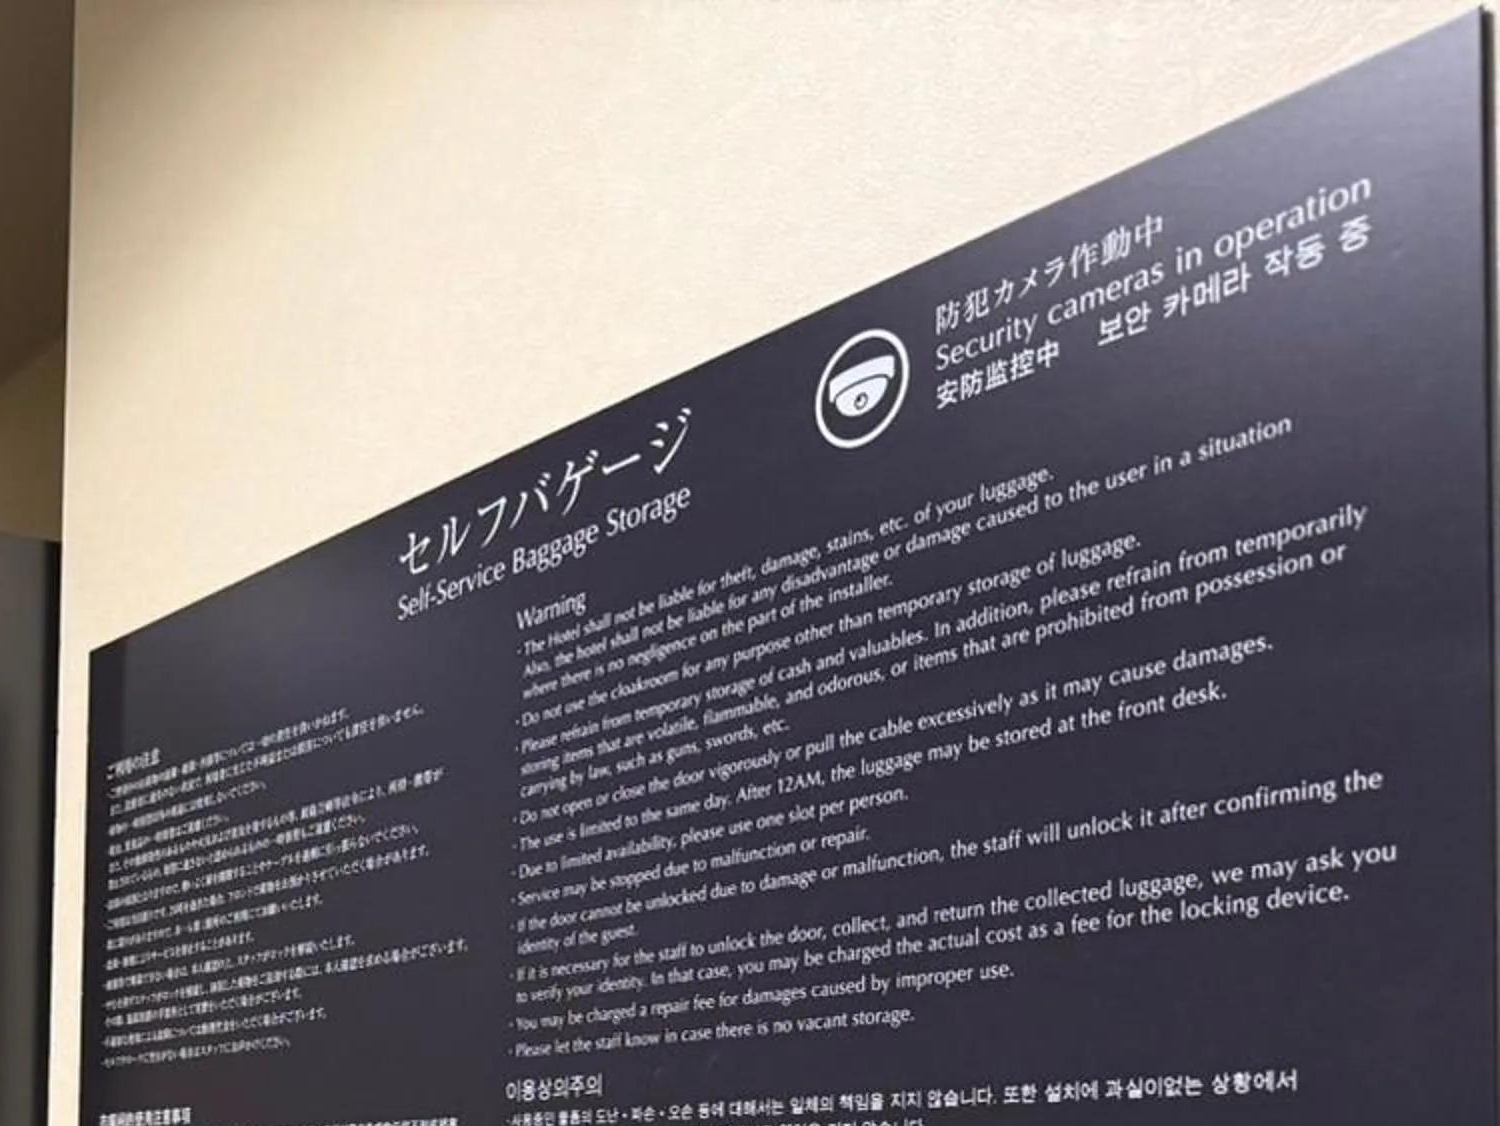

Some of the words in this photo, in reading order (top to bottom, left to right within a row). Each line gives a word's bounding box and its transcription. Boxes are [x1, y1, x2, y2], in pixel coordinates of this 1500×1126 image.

[936, 313, 1038, 371] Security
[1047, 262, 1164, 325] cameras
[1176, 246, 1202, 274] in
[1215, 178, 1370, 259] operation
[936, 215, 1163, 336] 防犯カメラ作動中
[1098, 301, 1152, 346] 보안
[1163, 262, 1251, 319] 카메라
[1264, 234, 1325, 277] 작동
[1339, 215, 1370, 253] 중
[936, 339, 1060, 410] 安防监控中
[399, 407, 692, 575] セルフバゲージ
[781, 551, 879, 593] disadvantage
[883, 544, 901, 560] or
[906, 522, 971, 554] damage
[975, 494, 1039, 531] caused
[1044, 492, 1063, 510] to
[1069, 480, 1100, 502] the
[1106, 464, 1148, 490] user
[1154, 455, 1172, 475] in
[1179, 451, 1191, 467] a
[1198, 417, 1292, 461] situation
[879, 517, 908, 536] etc.
[914, 501, 932, 524] of
[936, 493, 974, 522] your
[980, 468, 1054, 503] luggage.
[398, 561, 506, 621] Self-Service
[512, 524, 600, 574] Baggage
[606, 487, 691, 537] Storage
[838, 612, 873, 633] than
[878, 586, 962, 621] temporary
[968, 565, 1031, 596] storage
[1036, 551, 1055, 576] of
[1061, 534, 1141, 569] luggage.
[849, 629, 928, 661] valuables.
[934, 621, 951, 638] In
[956, 601, 1033, 633] addition,
[1040, 581, 1100, 615] please
[1107, 560, 1171, 591] refrain
[1179, 545, 1228, 572] from
[1235, 503, 1367, 557] temporarily
[516, 592, 587, 630] Warning
[890, 661, 908, 677] or
[914, 648, 958, 671] items
[963, 635, 996, 658] that
[1001, 628, 1030, 649] are
[1035, 595, 1134, 645] prohibited
[1141, 586, 1188, 612] from
[1195, 553, 1313, 604] possession
[1321, 544, 1347, 565] or
[705, 724, 758, 750] swords,
[708, 748, 782, 782] vigorously
[839, 729, 865, 749] the
[869, 716, 913, 741] cable
[917, 693, 1013, 730] excessively
[1019, 690, 1039, 707] as
[1046, 682, 1057, 701] it
[1063, 675, 1102, 697] may
[1109, 660, 1167, 686] cause
[1172, 636, 1273, 671] damages.
[778, 770, 825, 794] 12AM,
[861, 751, 923, 778] luggage
[927, 743, 963, 761] may
[968, 734, 991, 753] be
[995, 716, 1052, 747] stored
[1057, 715, 1075, 734] at
[1081, 707, 1113, 729] the
[1118, 695, 1165, 720] front
[1172, 680, 1227, 709] desk.
[843, 848, 944, 877] malfunction,
[950, 839, 978, 859] the
[983, 828, 1022, 854] staff
[1026, 822, 1060, 846] will
[1067, 810, 1133, 840] unlock
[1140, 808, 1153, 828] it
[1159, 800, 1208, 825] after
[1214, 779, 1338, 815] confirming
[1344, 769, 1383, 794] the
[849, 788, 909, 816] person.
[896, 906, 928, 929] and
[934, 903, 985, 923] return
[990, 895, 1019, 916] the
[1024, 880, 1112, 911] collected
[1119, 873, 1203, 902] luggage,
[1211, 867, 1244, 885] we
[1251, 859, 1298, 881] may
[1306, 846, 1344, 873] ask
[1351, 845, 1397, 872] you
[896, 936, 923, 955] the
[927, 925, 980, 951] actual
[985, 925, 1022, 945] cost
[1028, 923, 1048, 939] as
[1053, 921, 1065, 936] a
[1071, 913, 1100, 934] fee
[1106, 908, 1134, 929] for
[1140, 904, 1173, 926] the
[1181, 894, 1260, 920] locking
[1266, 883, 1350, 910] device.
[852, 1008, 915, 1029] storage.
[870, 973, 890, 995] by
[896, 967, 974, 992] improper
[980, 964, 1014, 980] use.
[505, 1073, 602, 1101] 이용상의주의
